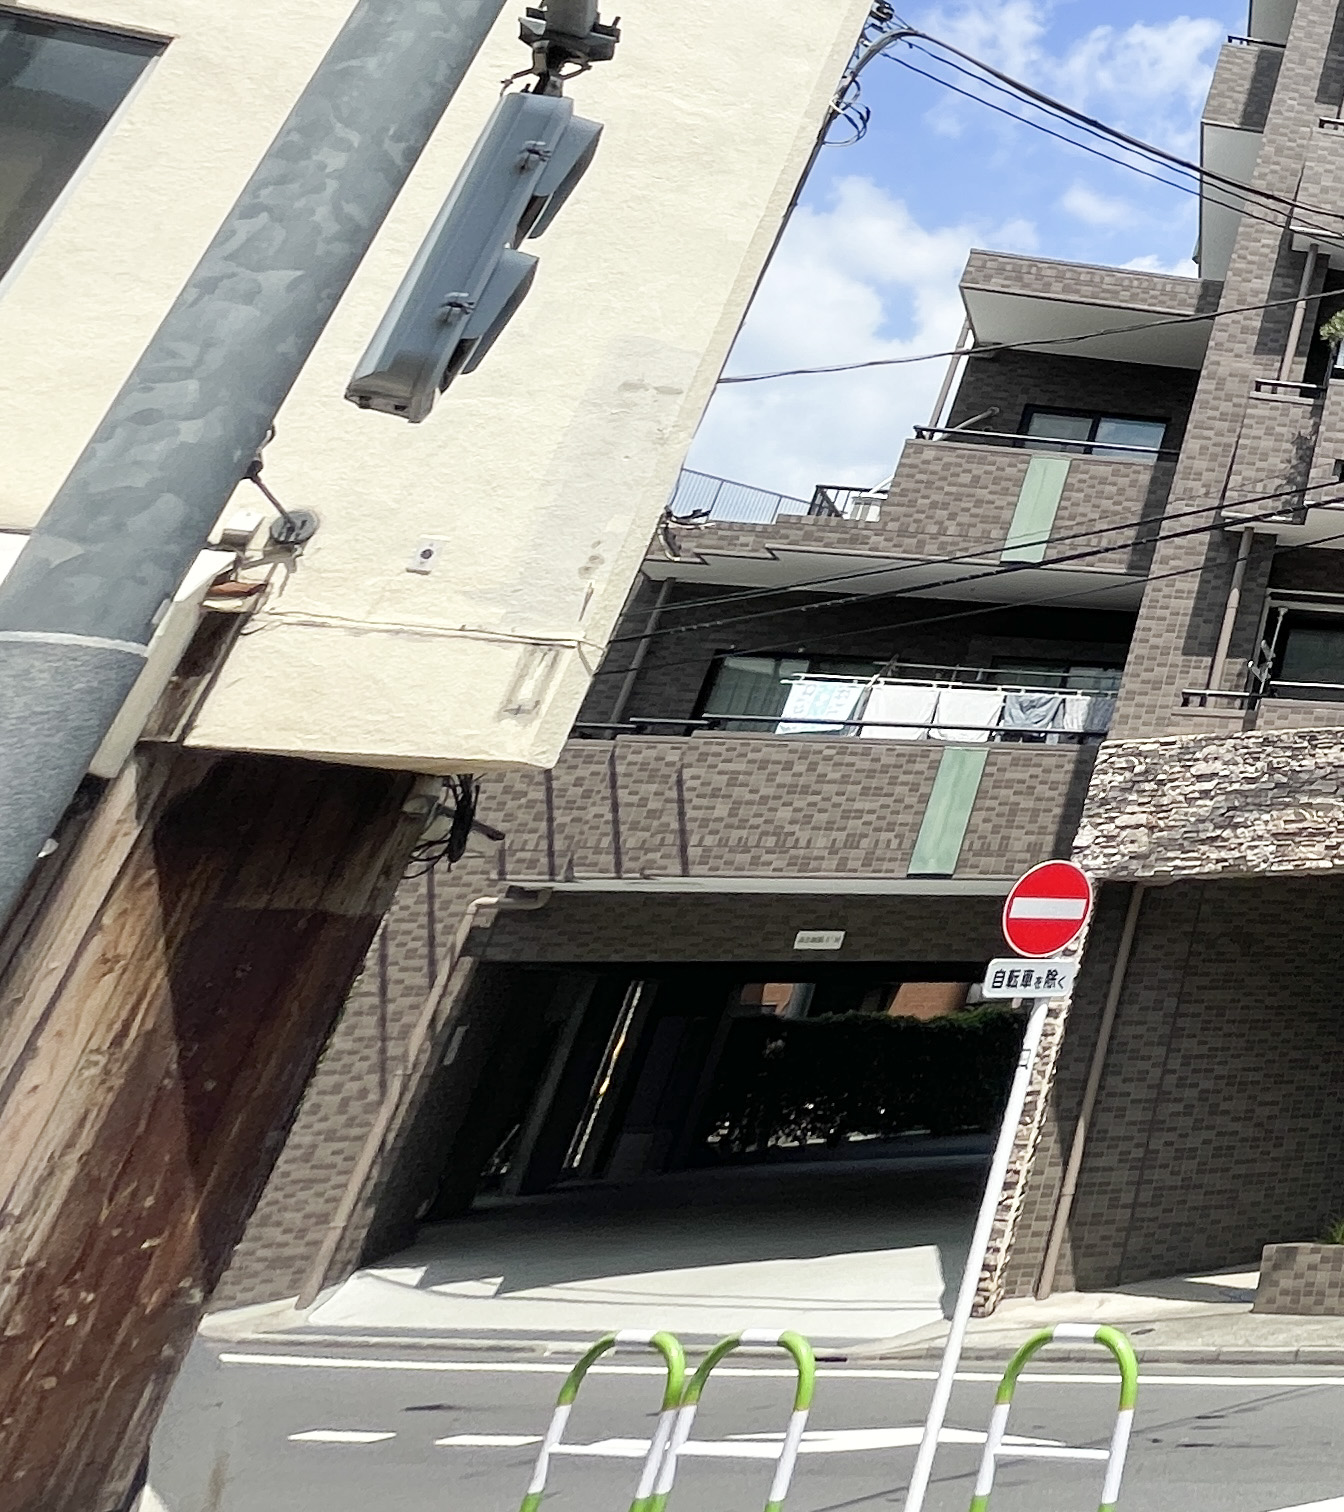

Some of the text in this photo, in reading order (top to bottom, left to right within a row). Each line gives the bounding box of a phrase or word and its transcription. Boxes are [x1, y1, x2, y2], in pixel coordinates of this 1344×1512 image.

[992, 969, 1066, 989] 自転車を除く
